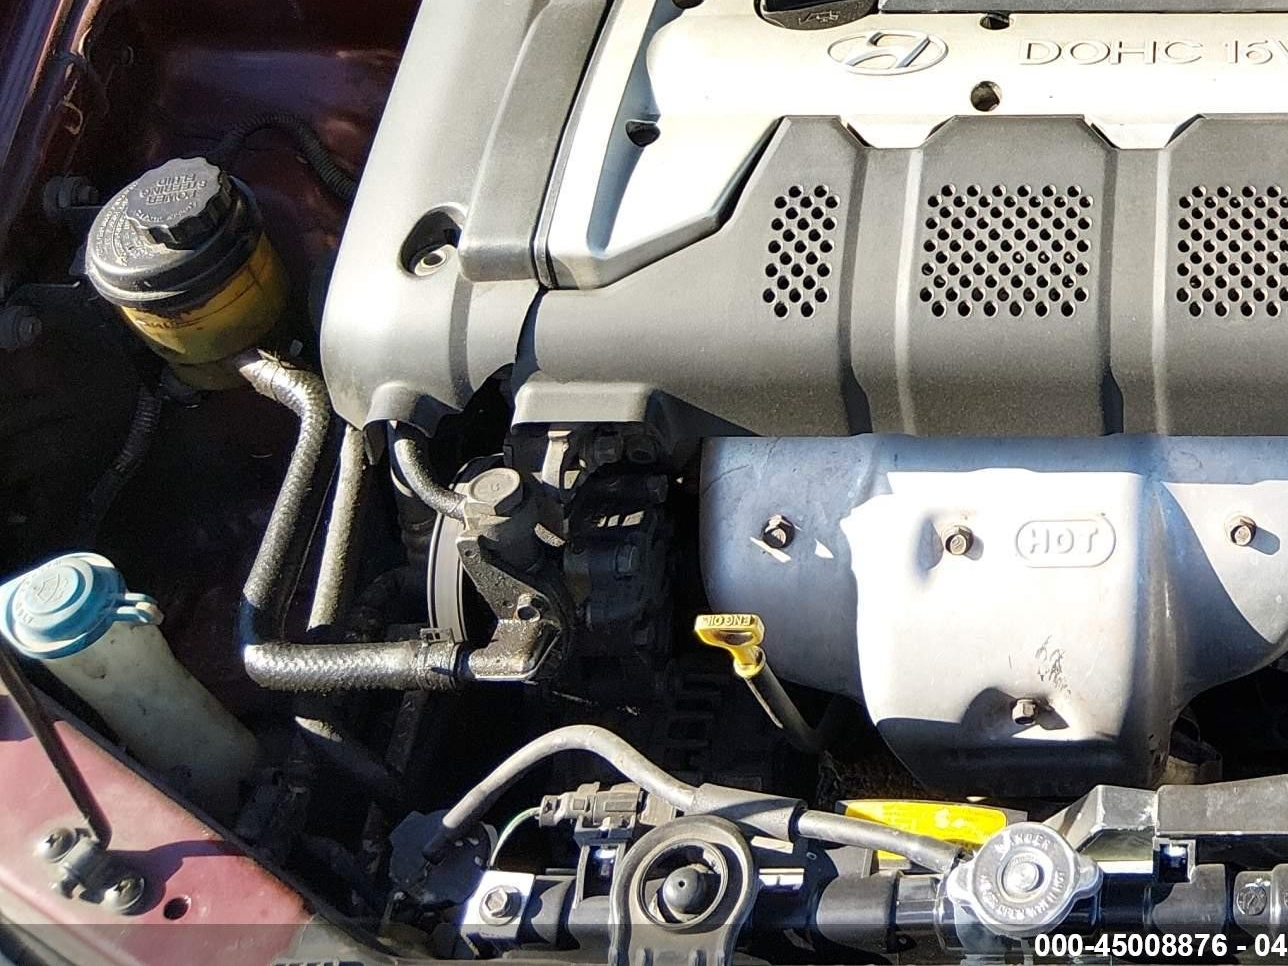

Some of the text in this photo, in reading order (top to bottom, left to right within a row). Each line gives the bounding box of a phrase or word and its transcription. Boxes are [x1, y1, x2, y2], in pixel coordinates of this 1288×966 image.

[1019, 38, 1203, 66] DOHC
[139, 181, 207, 198] STEERING
[157, 173, 196, 185] FLUID
[1025, 526, 1100, 555] HOT
